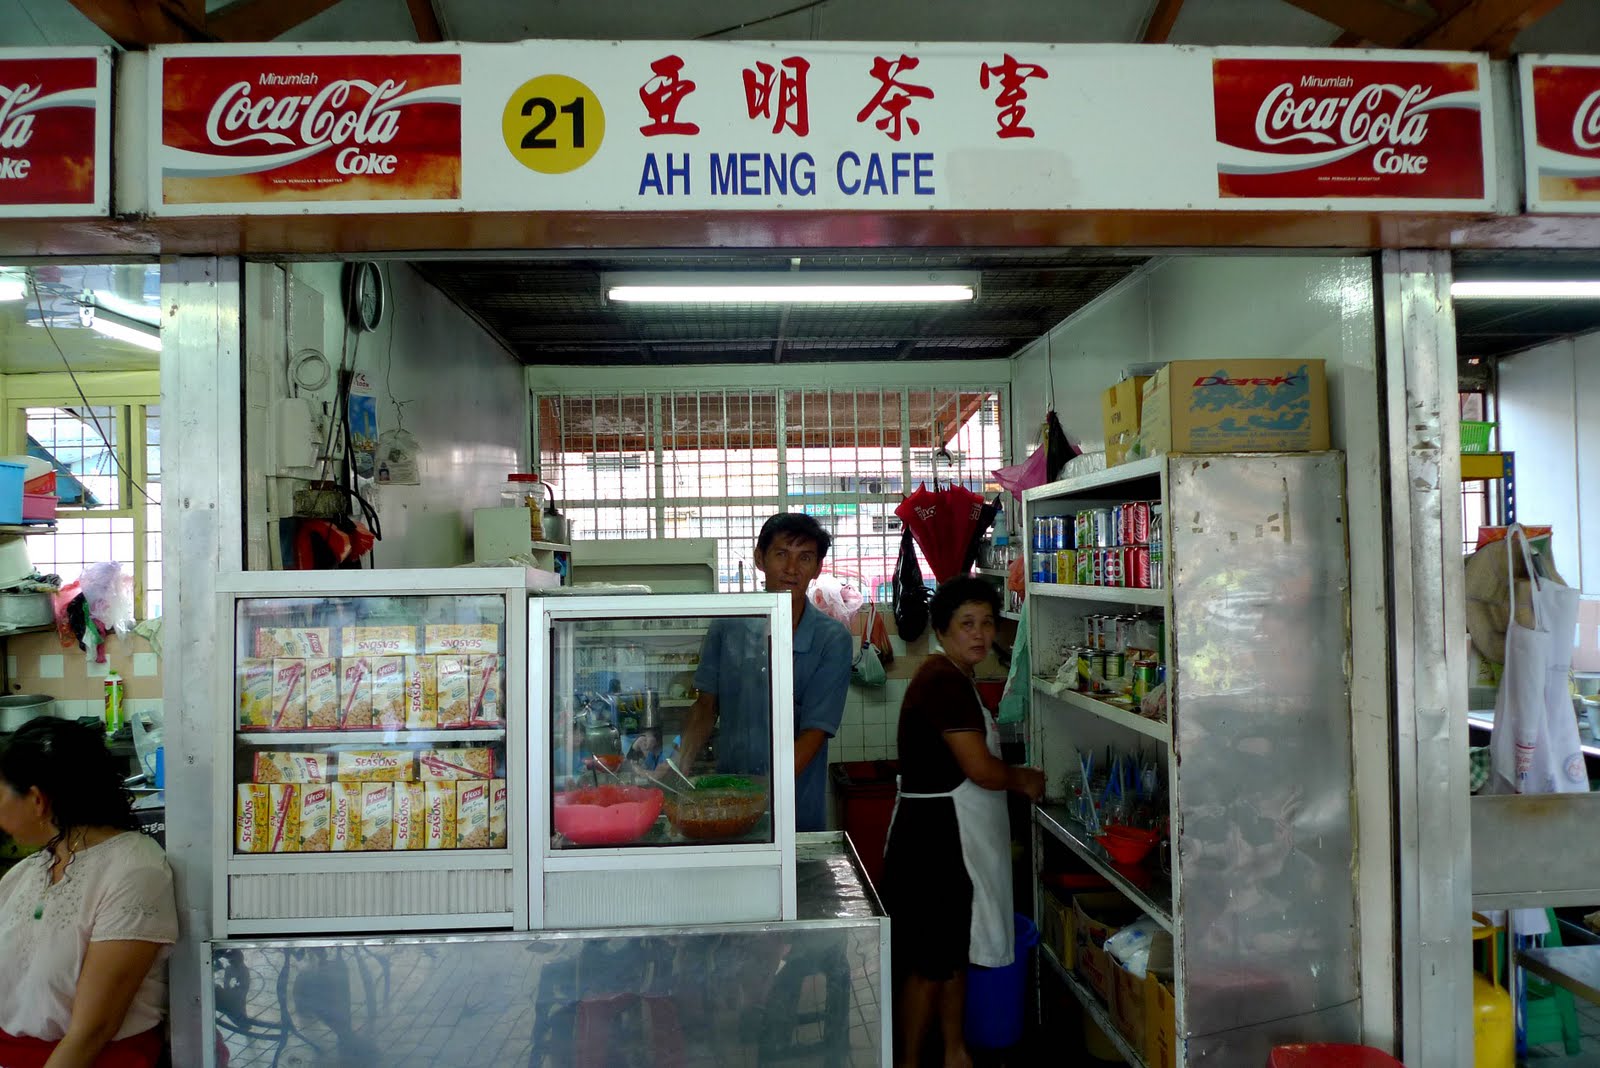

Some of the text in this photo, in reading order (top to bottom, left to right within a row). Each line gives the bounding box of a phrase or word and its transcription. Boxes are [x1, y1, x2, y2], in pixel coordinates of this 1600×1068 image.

[259, 72, 318, 85] Minumlah
[1300, 75, 1354, 88] Minumlah
[206, 79, 407, 146] Coca-Cola
[520, 97, 585, 149] 21
[1255, 83, 1432, 146] Coca-Cola
[0, 157, 31, 179] ke
[335, 147, 398, 175] Coke
[638, 151, 936, 196] AH MENG CAFE
[1373, 147, 1428, 175] Coke
[412, 671, 421, 712] SEASONS
[355, 757, 398, 767] SEASONS
[307, 790, 324, 803] Yeo's
[368, 789, 386, 801] Yeo's
[464, 788, 482, 801] Yeo's
[243, 800, 253, 842] SEASONS
[337, 798, 346, 840] SEASONS
[399, 797, 409, 839] SEASONS
[432, 797, 441, 839] SEASONS
